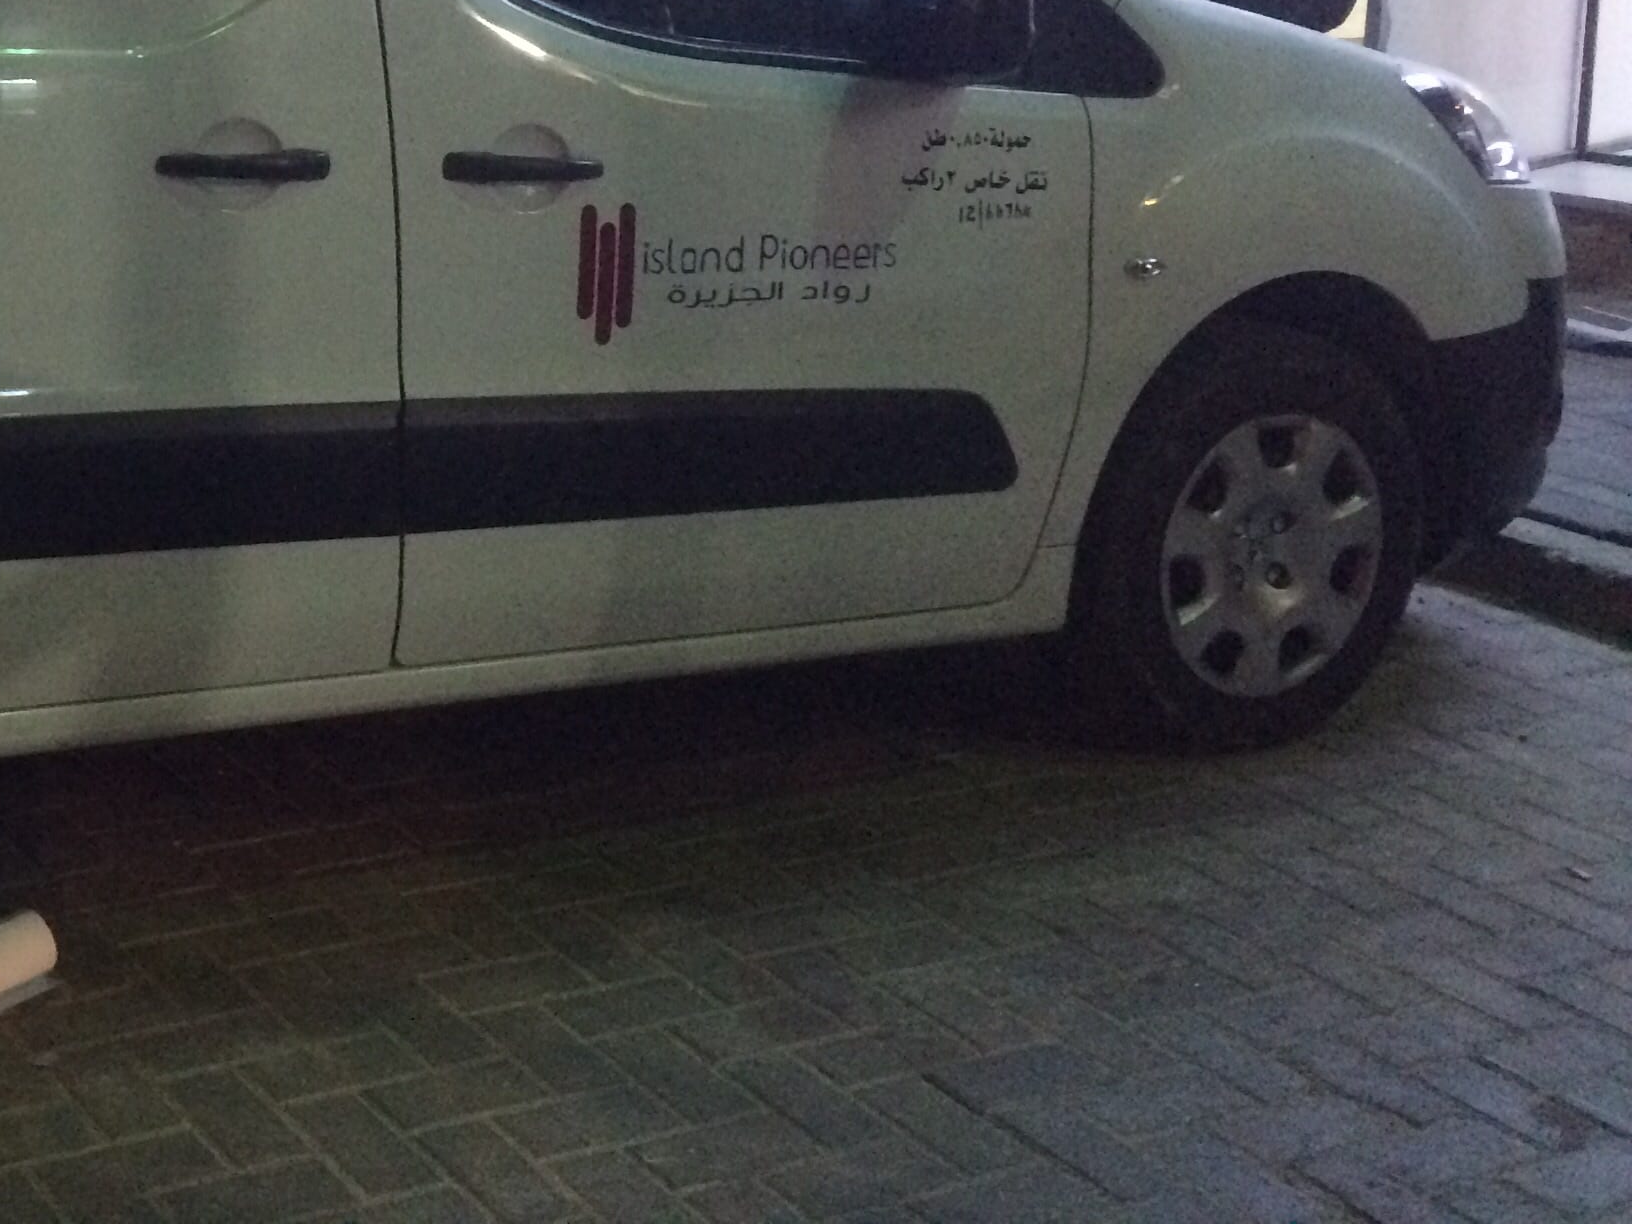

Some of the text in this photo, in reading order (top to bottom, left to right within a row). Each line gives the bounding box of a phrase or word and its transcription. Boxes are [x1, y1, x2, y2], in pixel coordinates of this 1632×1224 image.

[759, 233, 897, 272] Pioneers
[668, 279, 871, 309] رواد الجزيرة
